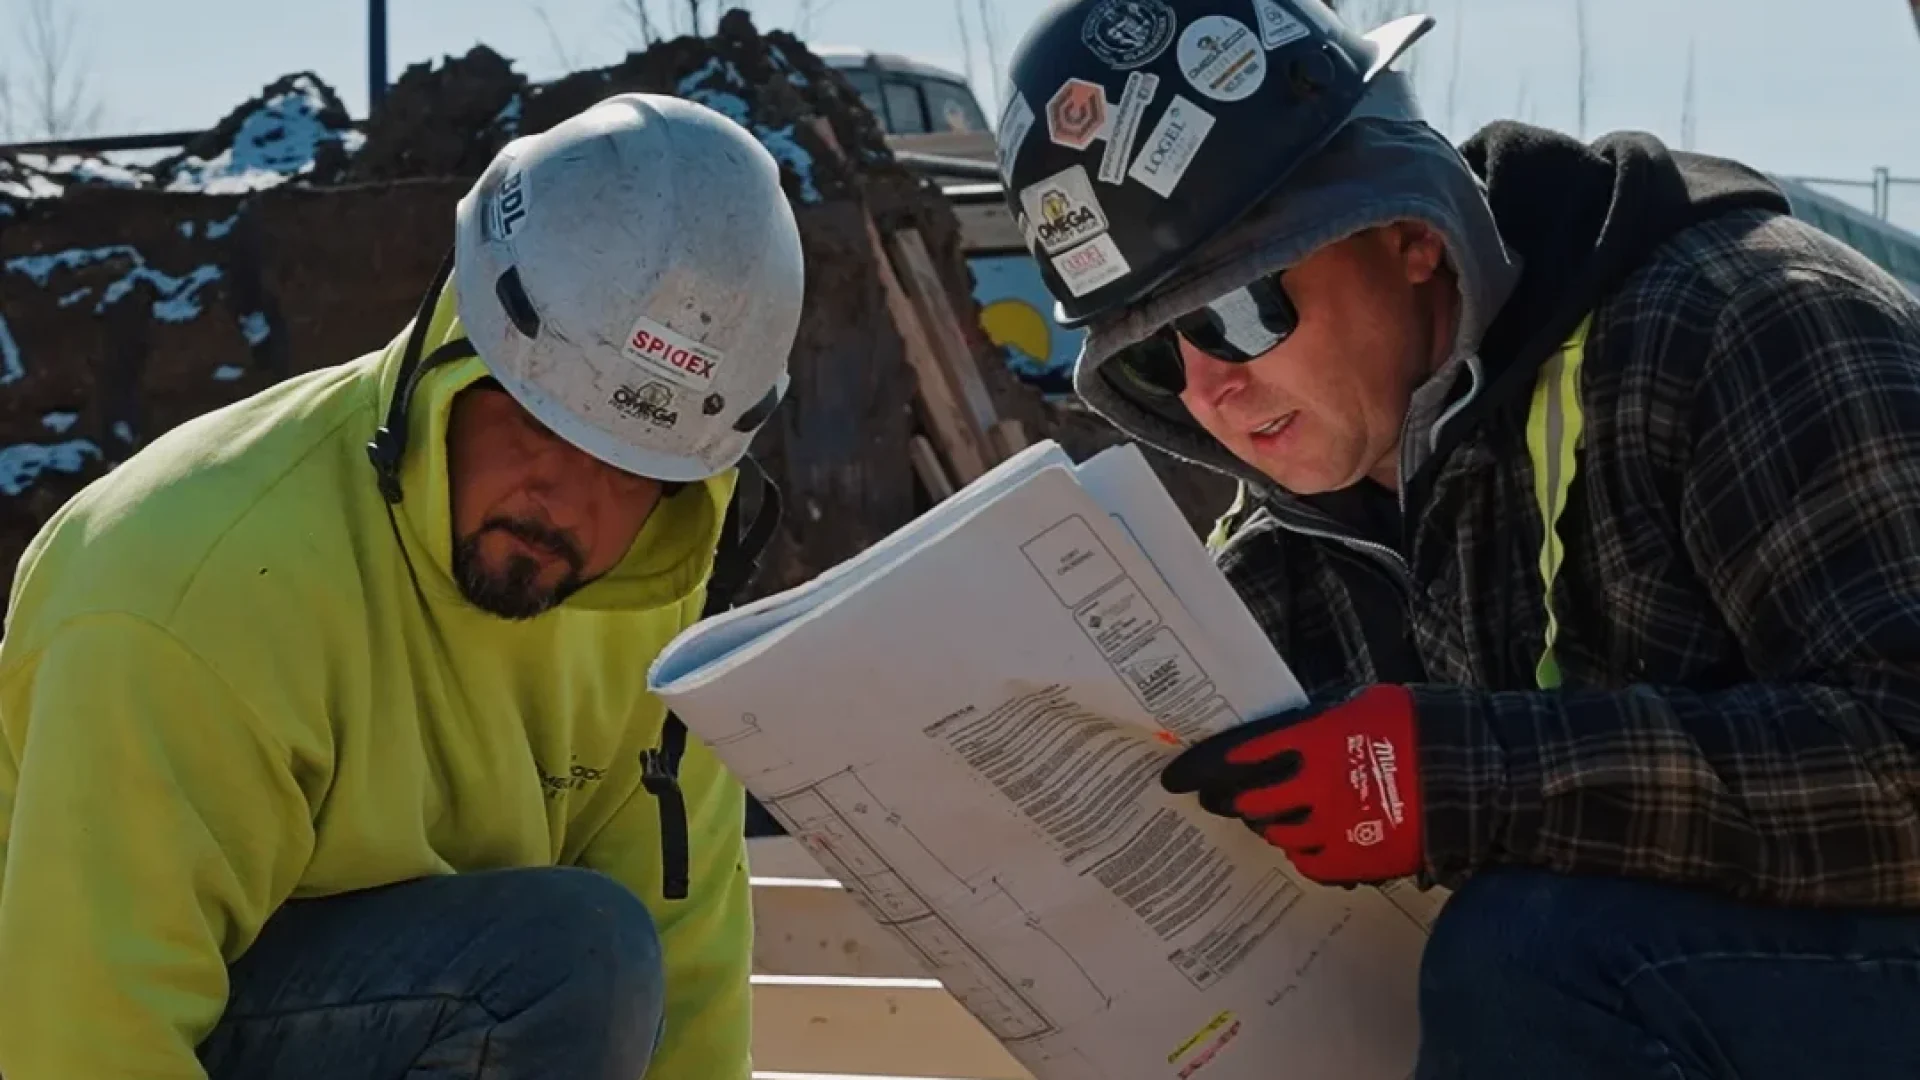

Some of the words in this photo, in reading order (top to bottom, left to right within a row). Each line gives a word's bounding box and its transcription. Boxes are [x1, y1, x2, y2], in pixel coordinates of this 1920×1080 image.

[1144, 117, 1187, 175] LOGEL
[1038, 205, 1096, 239] OMEGA
[612, 387, 678, 426] OMEGA
